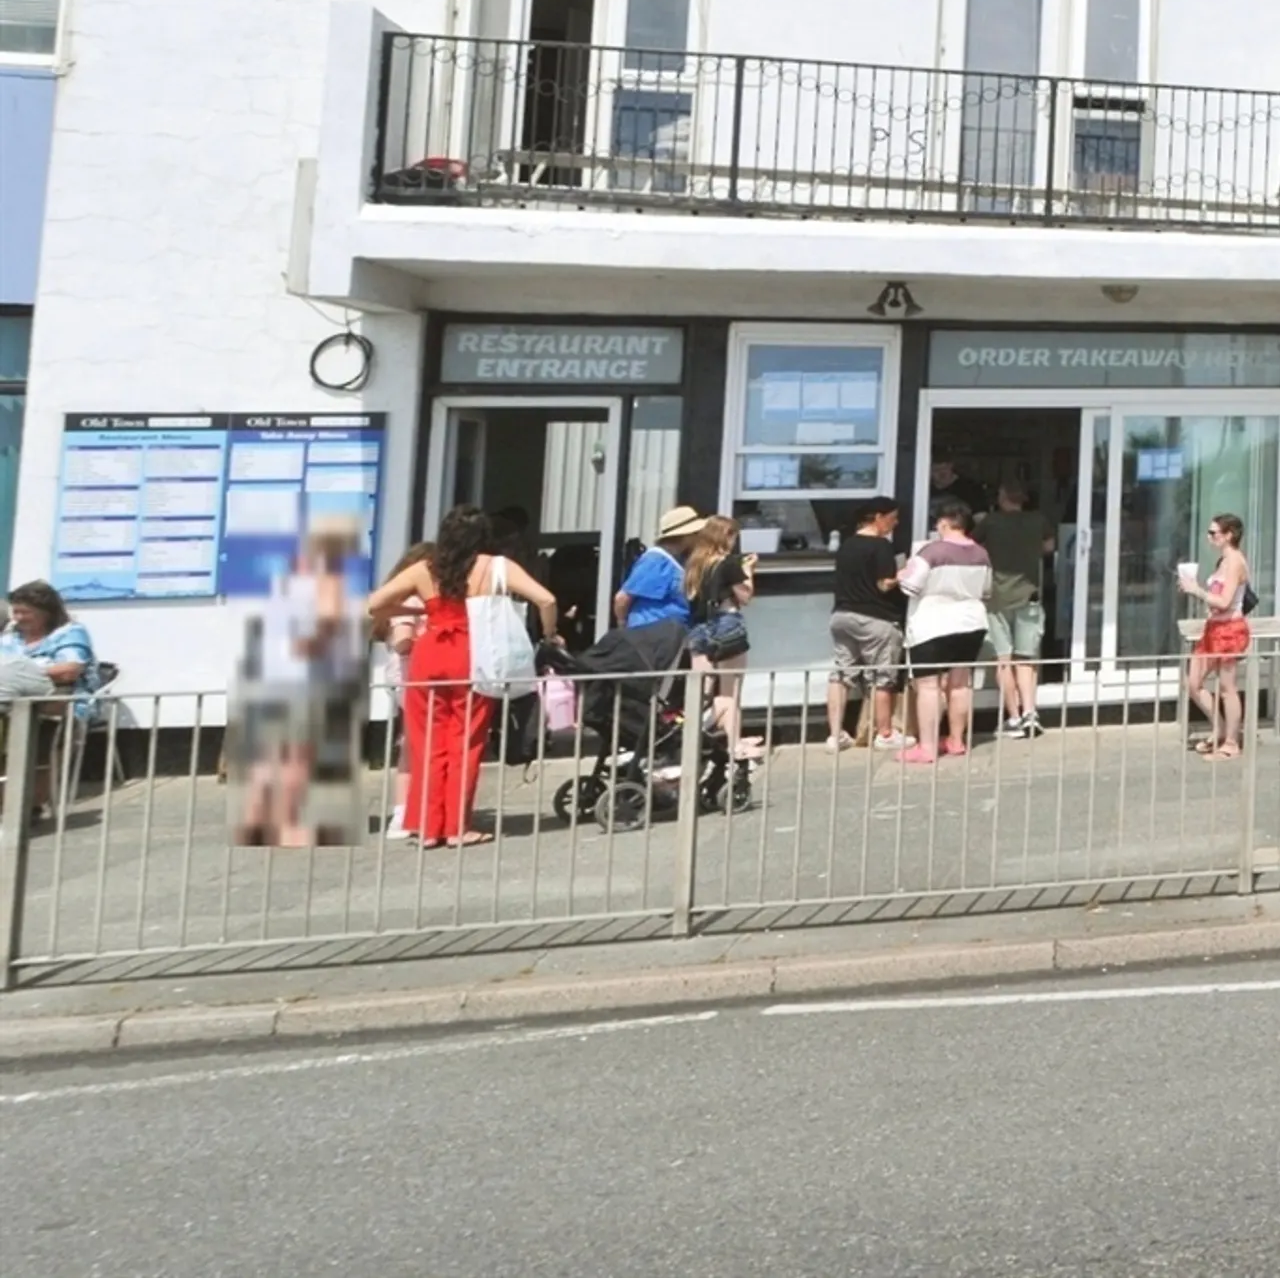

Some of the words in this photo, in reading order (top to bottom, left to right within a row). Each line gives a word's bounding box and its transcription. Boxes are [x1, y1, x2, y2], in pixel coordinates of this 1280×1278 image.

[457, 331, 670, 356] RESTAURANT
[476, 357, 649, 380] ENTRANCE
[957, 347, 1051, 367] ORDER
[1057, 347, 1198, 370] TAKEAWAY
[80, 417, 108, 428] Old
[247, 416, 272, 428] Old
